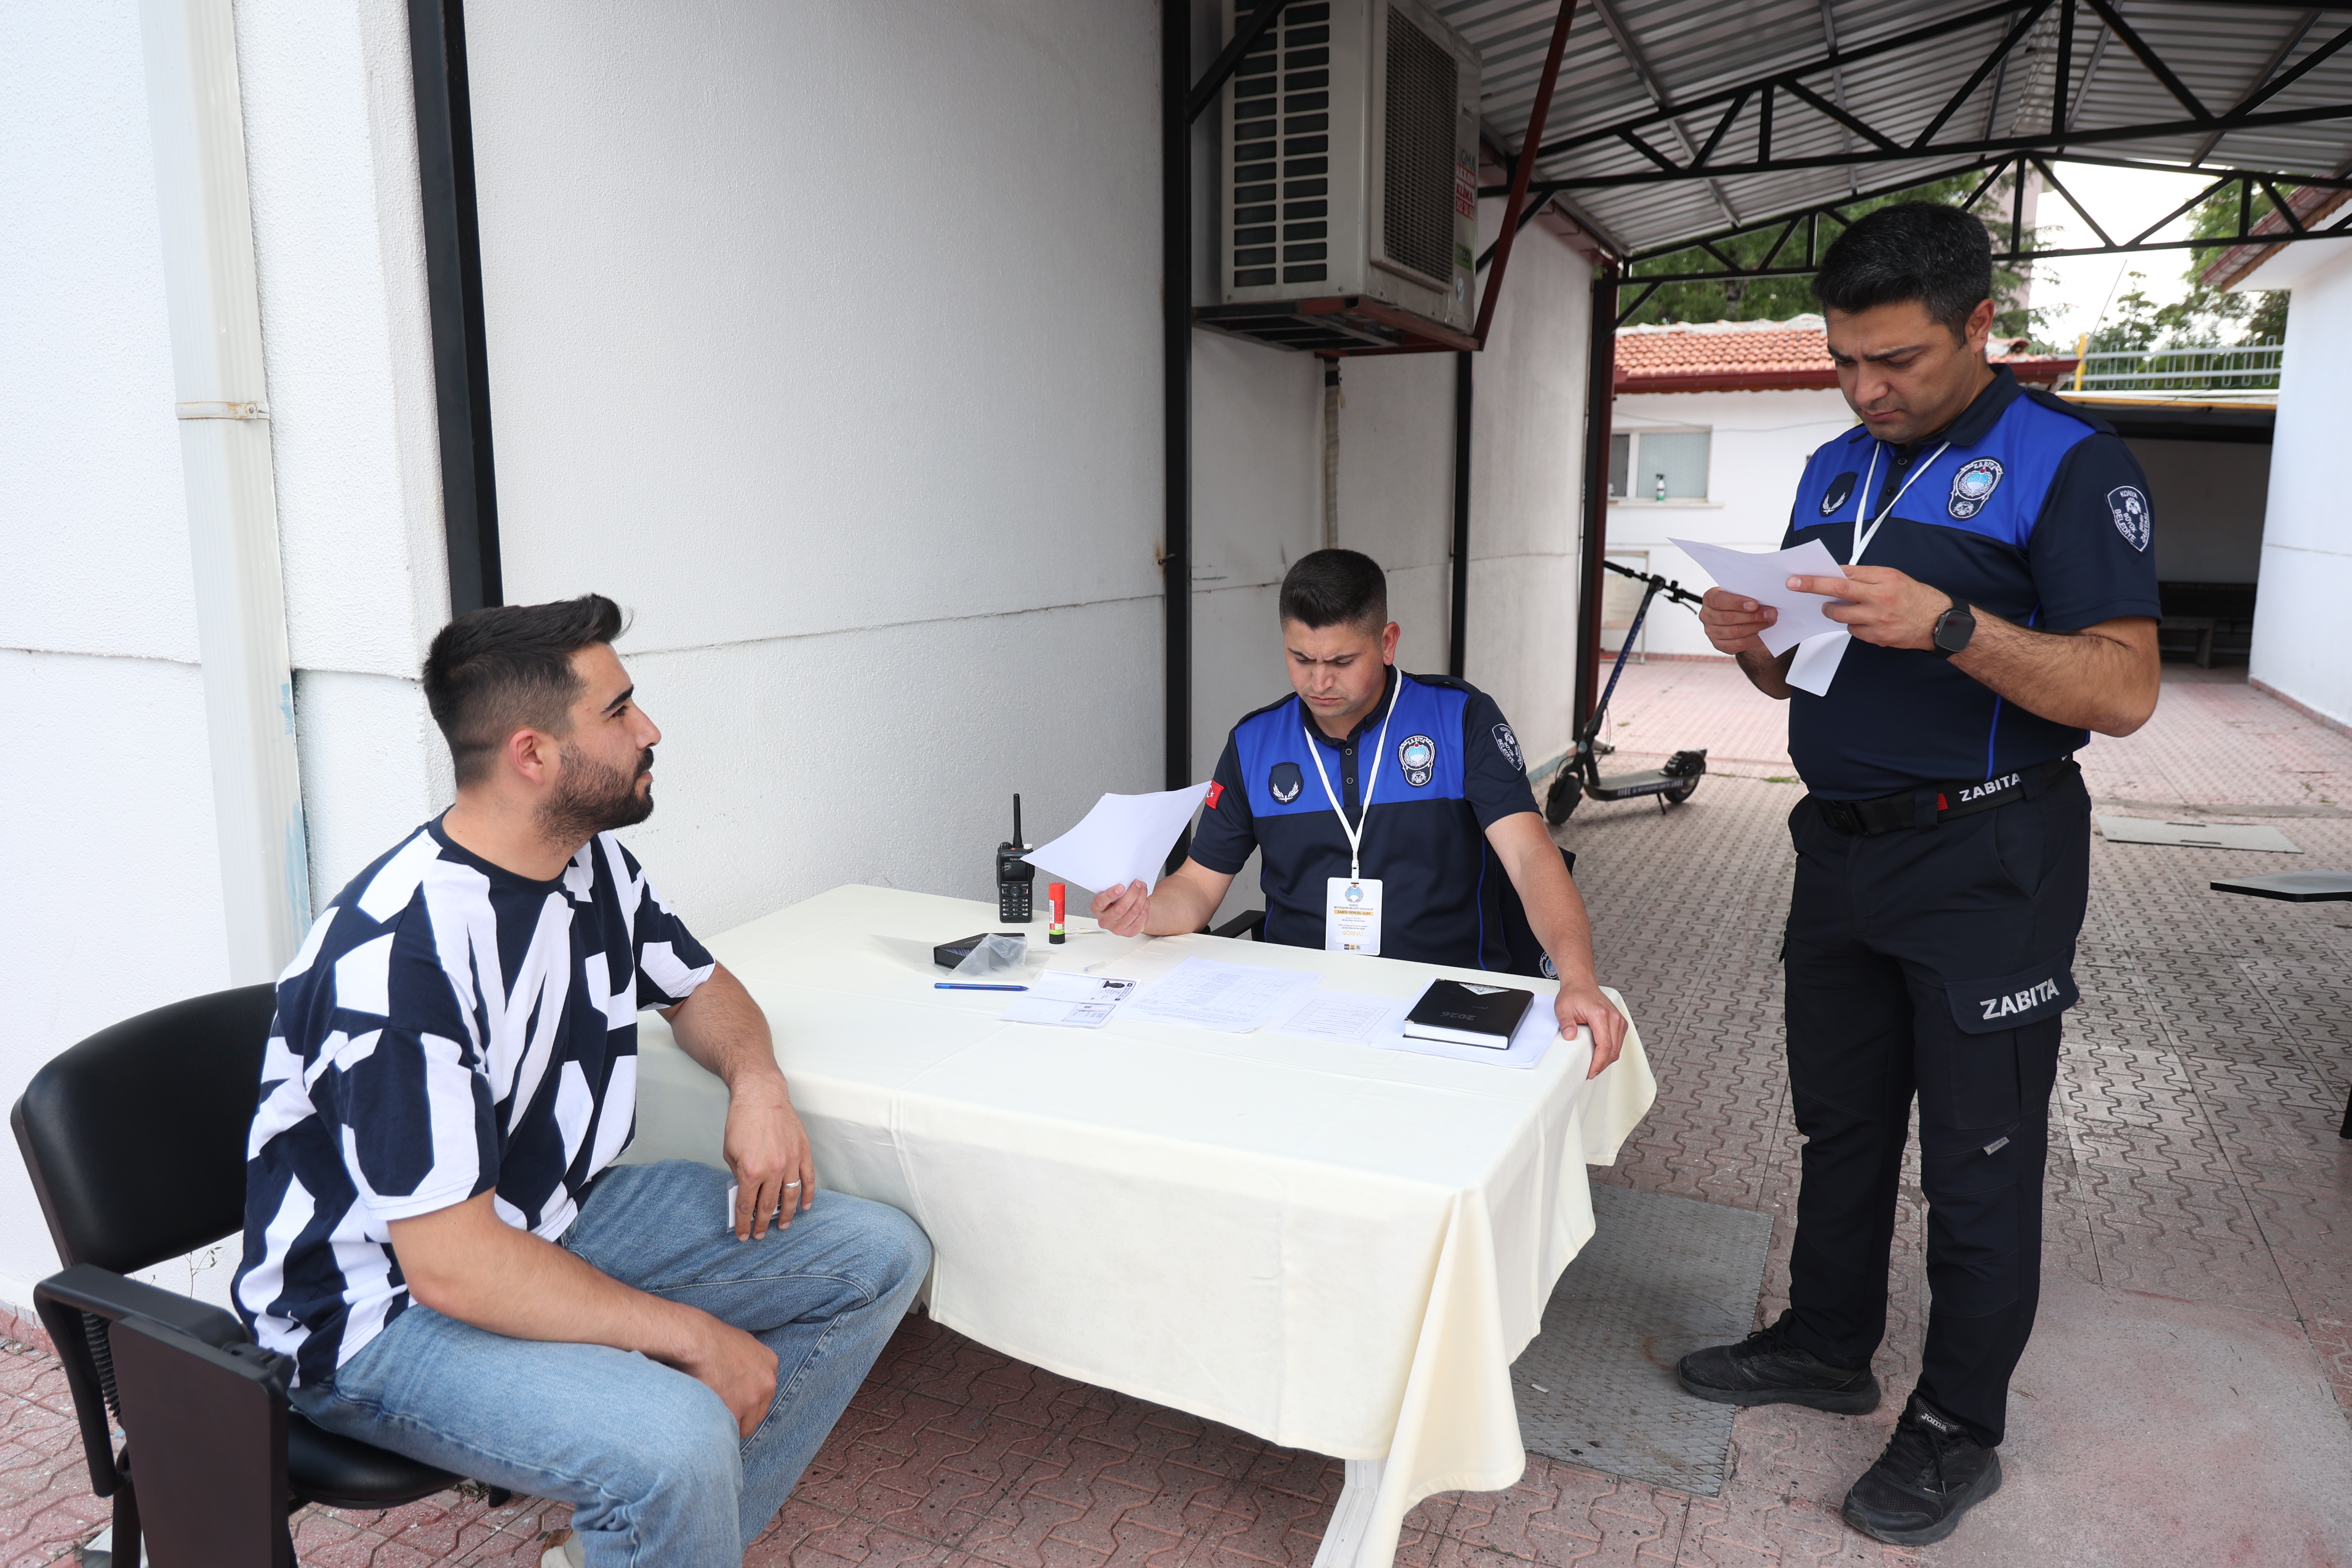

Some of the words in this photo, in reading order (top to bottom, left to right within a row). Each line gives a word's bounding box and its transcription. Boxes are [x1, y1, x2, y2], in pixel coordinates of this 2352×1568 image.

[1974, 461, 1997, 470] ZABITA
[2120, 490, 2138, 499] KONYA
[1407, 737, 1426, 745] ZABITA
[1959, 773, 2021, 802] ZABITA
[1980, 978, 2060, 1020] ZABITA
[1440, 1011, 1476, 1020] 2026
